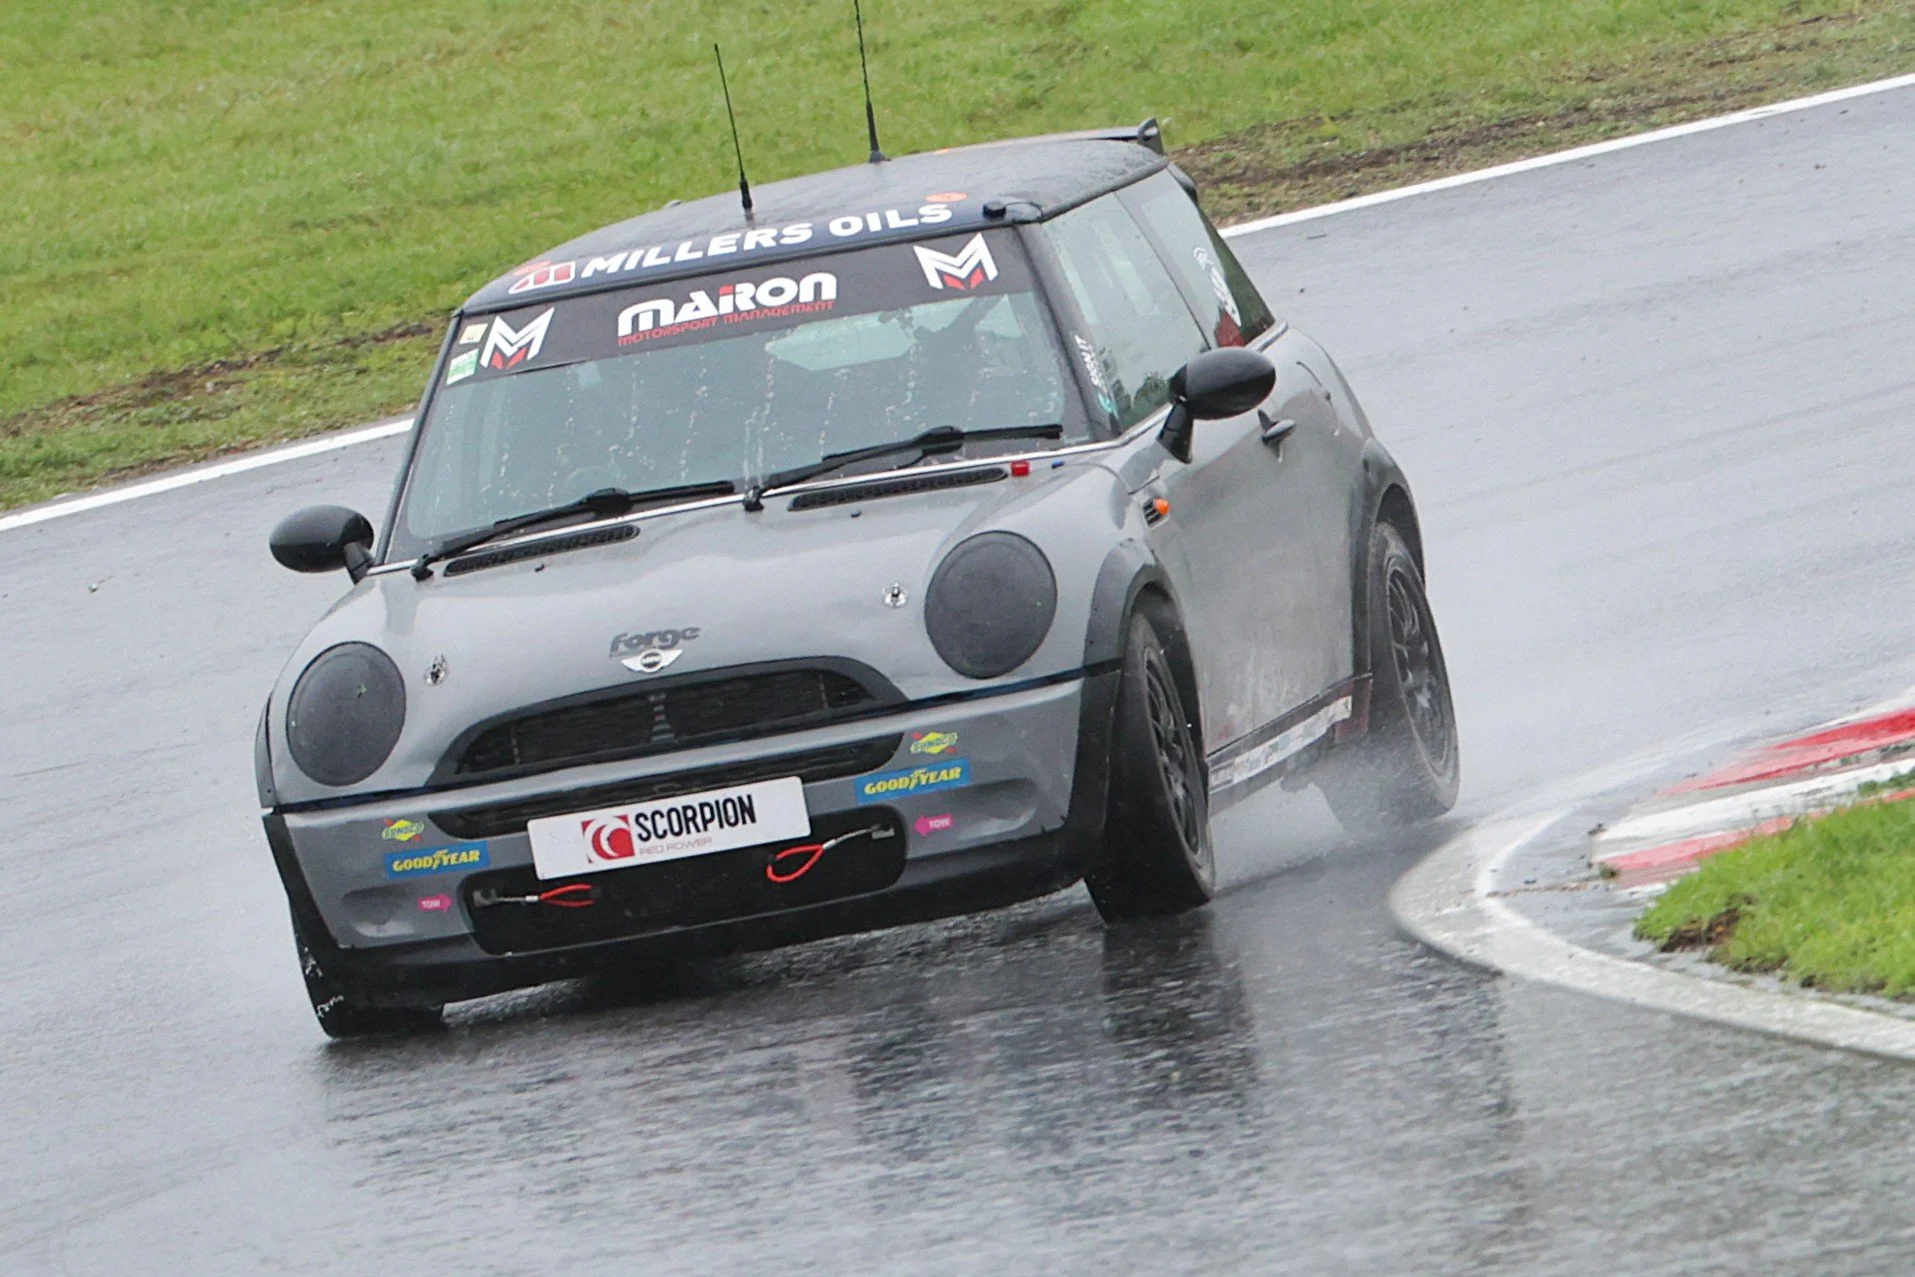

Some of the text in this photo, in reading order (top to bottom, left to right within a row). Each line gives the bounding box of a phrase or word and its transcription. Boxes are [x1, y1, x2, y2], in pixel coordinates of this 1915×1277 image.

[580, 203, 953, 279] MILLERS OILS
[618, 300, 836, 347] MOTORSPORT MANAGEMENT
[864, 767, 962, 794] GOODYEAR
[634, 794, 756, 842] SCORPION
[928, 816, 951, 830] TOW
[392, 849, 481, 872] GOODYEAR
